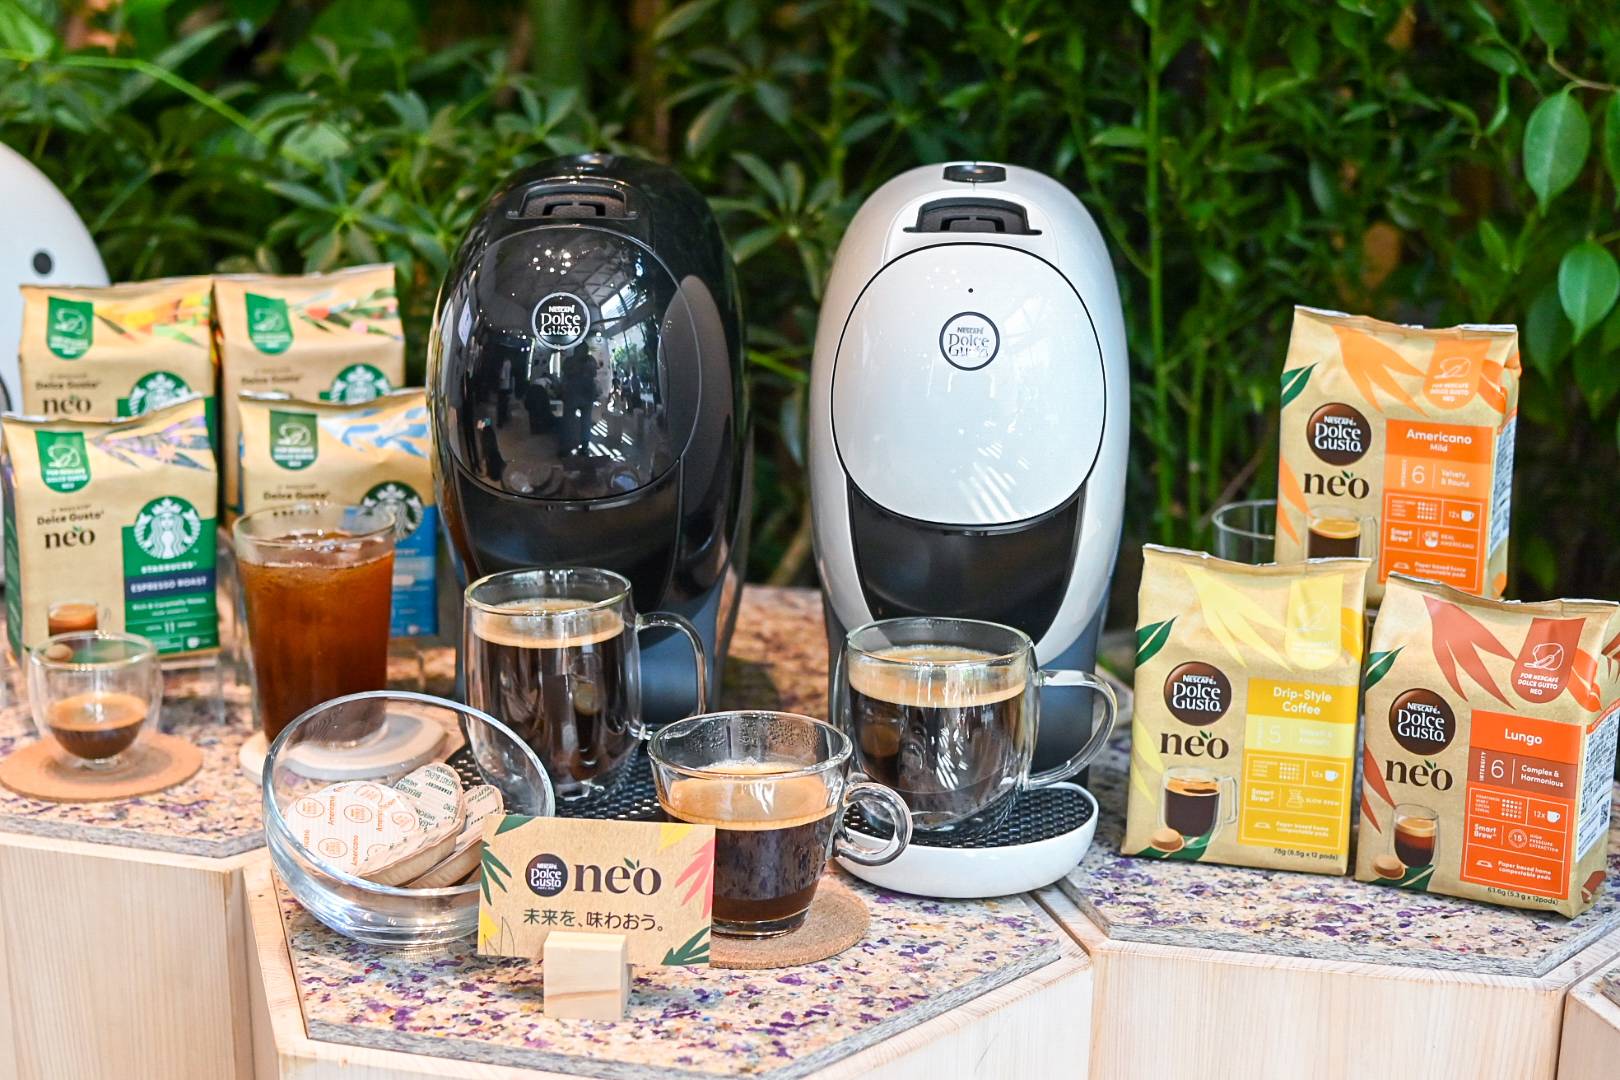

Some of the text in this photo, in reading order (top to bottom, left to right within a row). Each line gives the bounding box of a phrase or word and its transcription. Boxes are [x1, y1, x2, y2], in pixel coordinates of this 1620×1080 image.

[540, 313, 581, 326] Dolce
[540, 324, 581, 336] Gusto
[948, 333, 990, 347] Dolce
[43, 397, 92, 415] neo
[1315, 422, 1361, 441] Dolce
[1406, 429, 1473, 445] Americano
[1314, 436, 1362, 452] Gusto
[1430, 444, 1449, 453] Mild
[1411, 465, 1425, 485] 6
[1303, 472, 1370, 500] neo
[45, 528, 96, 549] neo
[1183, 675, 1215, 685] NESCAFÉ
[1517, 679, 1558, 690] DOLCE GUSTO
[1173, 682, 1221, 700] Dolce
[1273, 686, 1333, 704] Drip-Style
[1172, 695, 1221, 712] Gusto
[1282, 701, 1321, 716] Coffee
[1407, 702, 1440, 714] NESCAFÉ
[1398, 709, 1445, 730] Dolce
[1397, 722, 1446, 743] Gusto
[1504, 728, 1543, 746] Lungo
[1160, 732, 1229, 760] neo
[1385, 759, 1454, 791] neo
[1491, 759, 1505, 779] 6
[1521, 764, 1560, 778] Complex &
[1520, 773, 1564, 788] Harmonious
[1533, 810, 1546, 819] 12x
[1474, 824, 1497, 834] Smart
[531, 868, 562, 880] Dolce
[573, 863, 662, 896] neo
[530, 877, 562, 888] Gusto
[523, 908, 663, 932] 未来を、味わおう。
